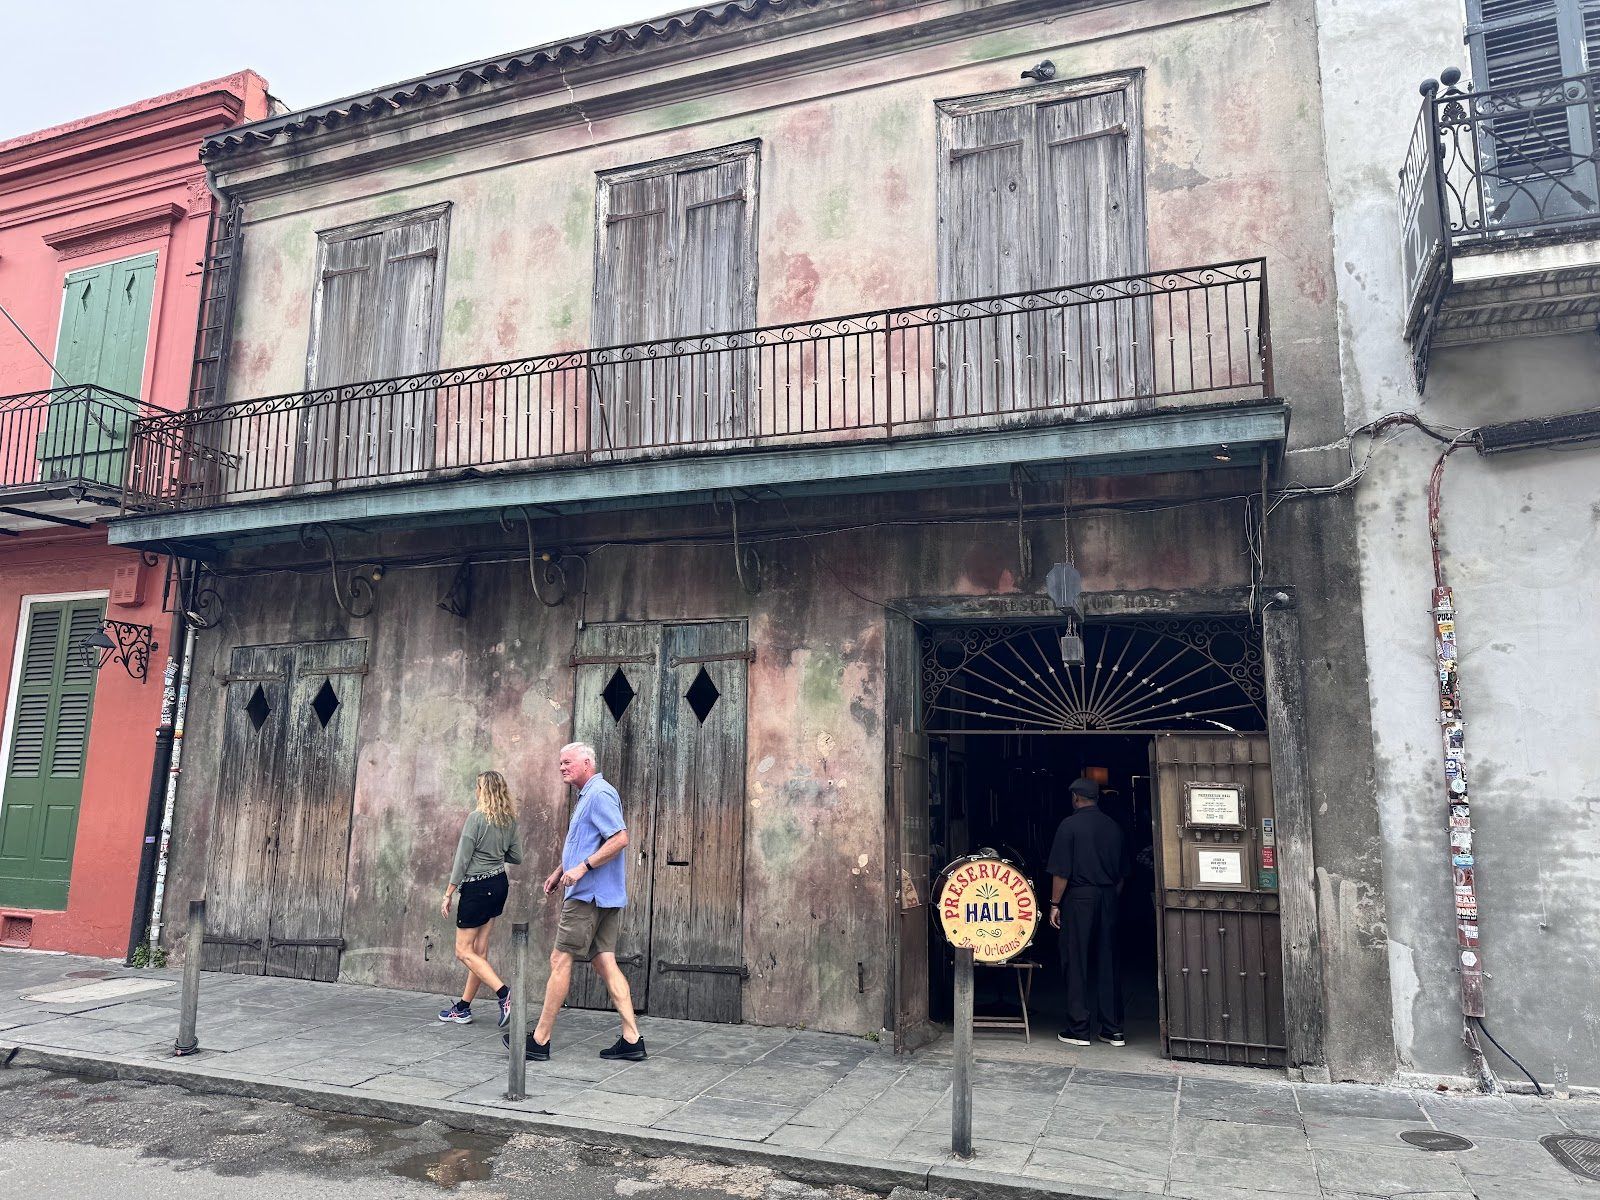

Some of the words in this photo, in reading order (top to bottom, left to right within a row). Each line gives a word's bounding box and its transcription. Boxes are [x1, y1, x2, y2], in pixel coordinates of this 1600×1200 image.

[944, 863, 1033, 922] PRESERVATION
[965, 901, 1014, 924] HALL
[984, 937, 1021, 957] Orleans
